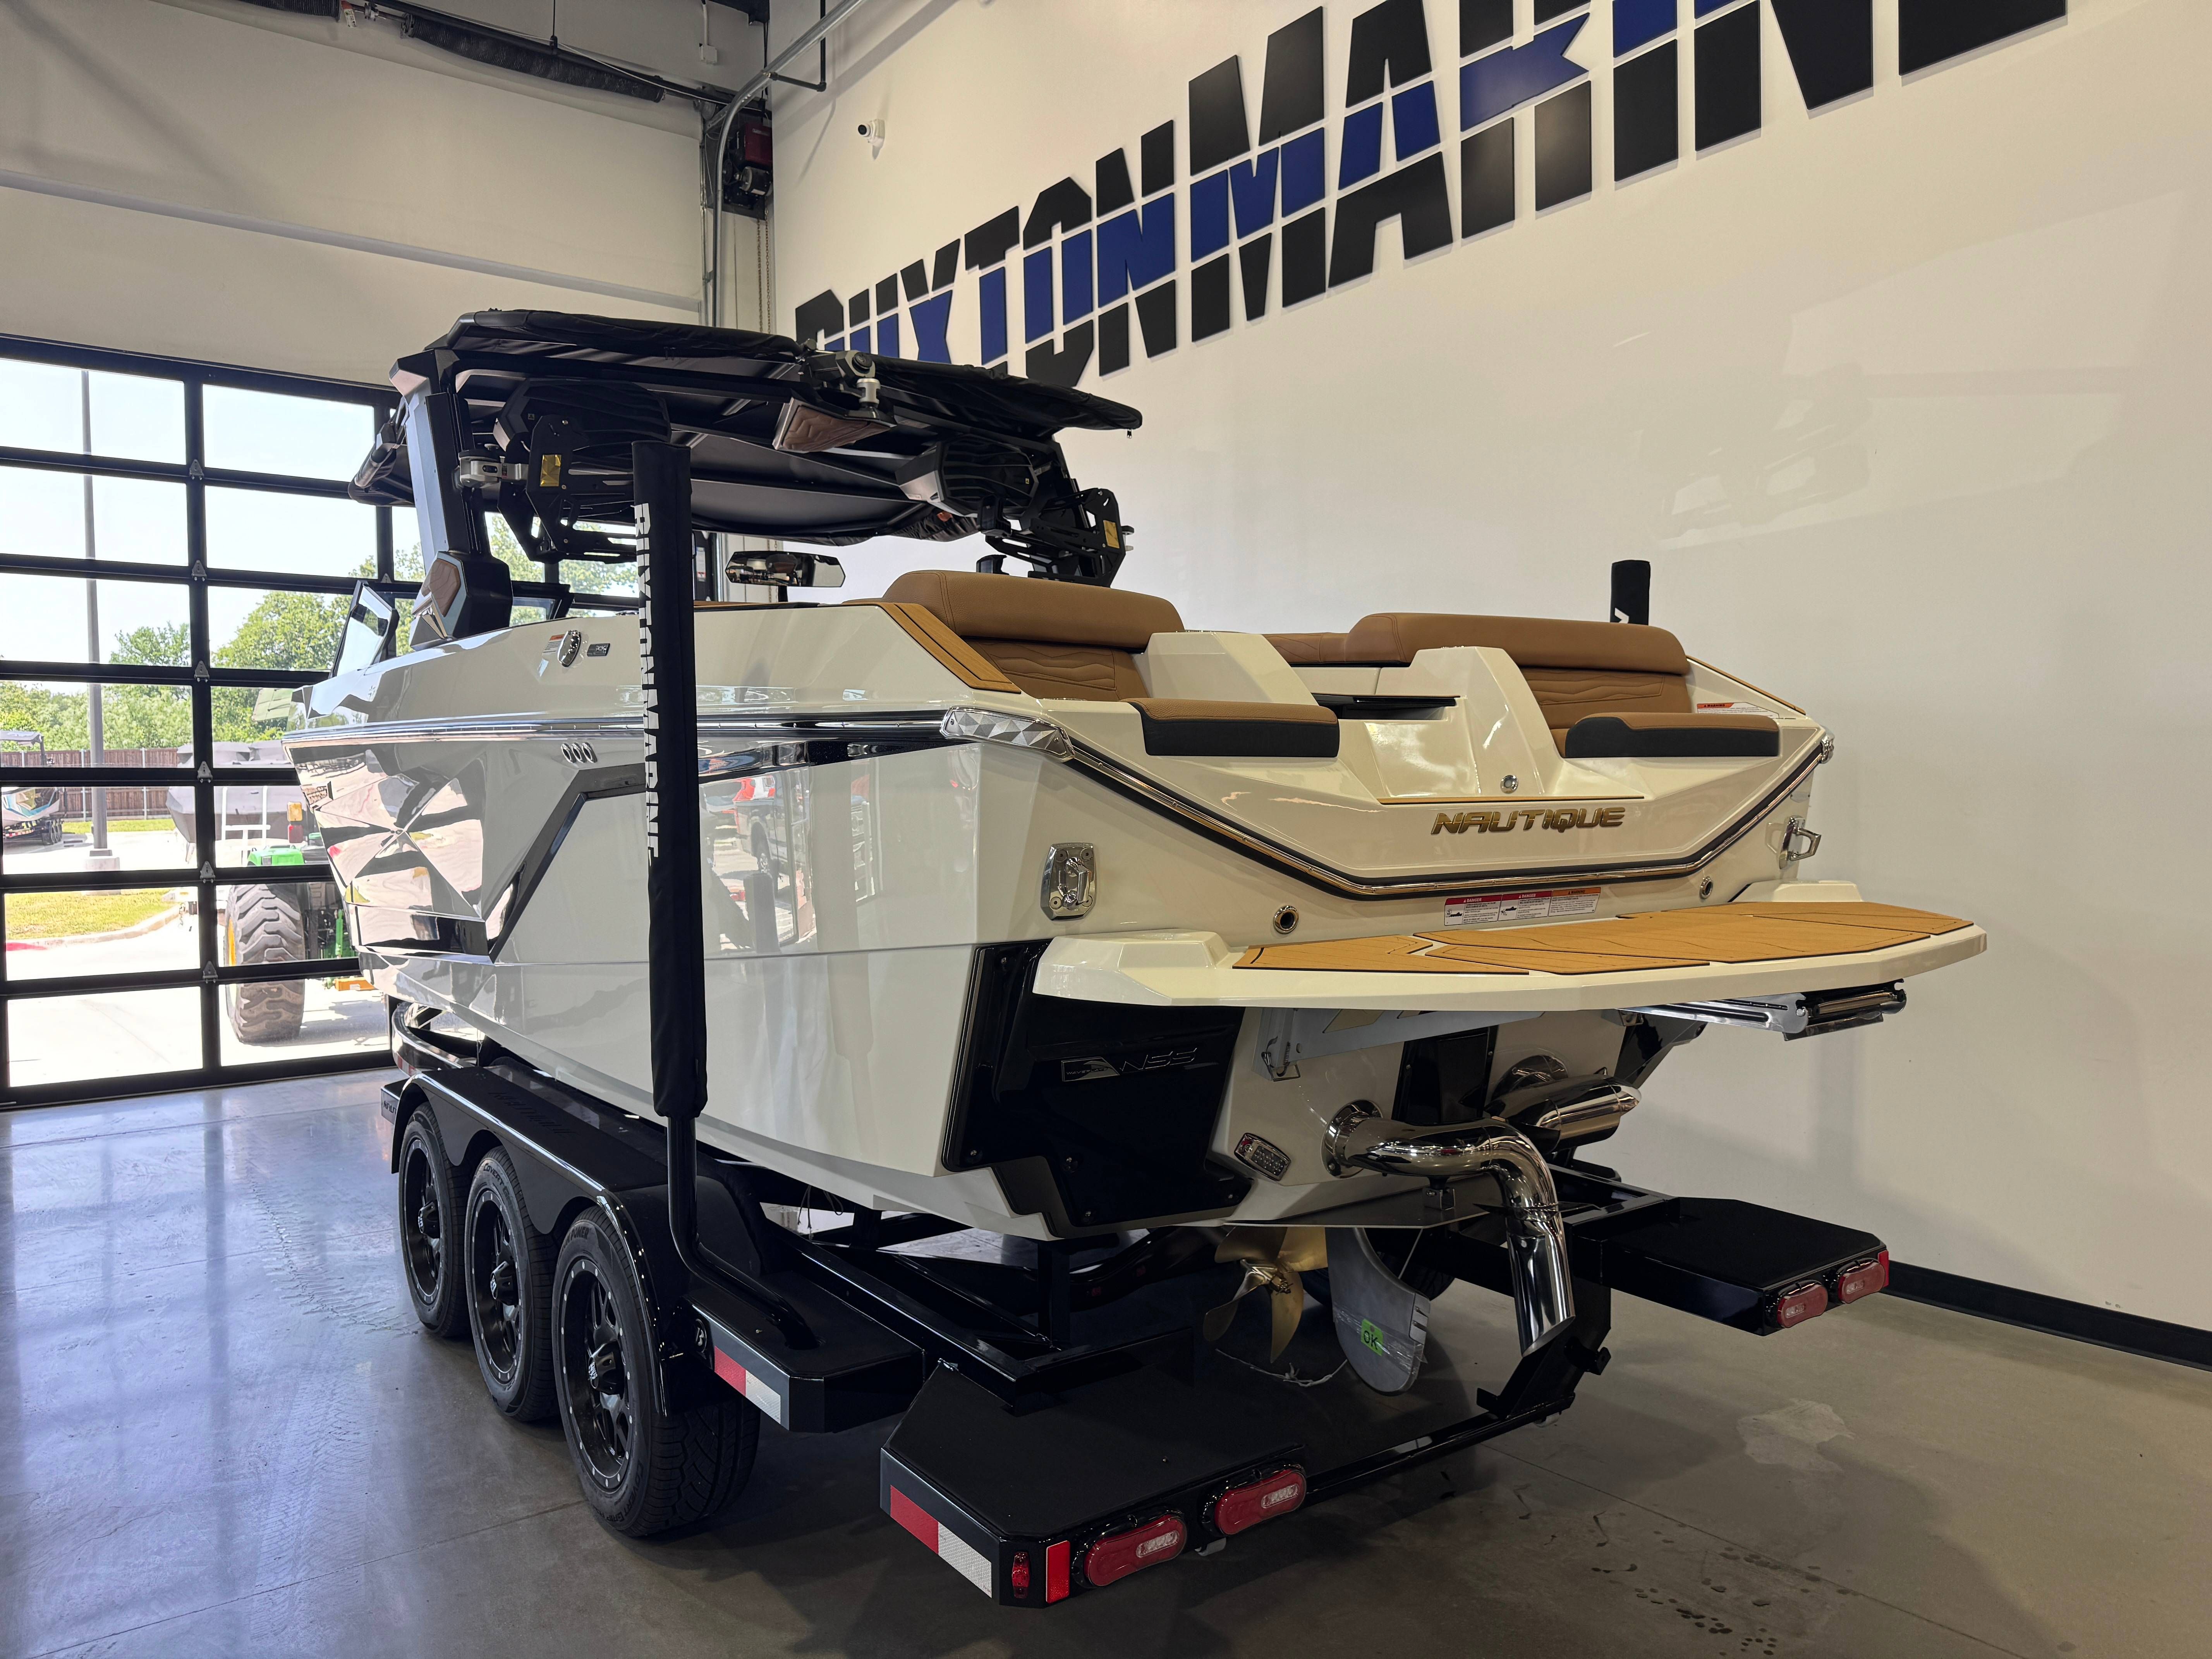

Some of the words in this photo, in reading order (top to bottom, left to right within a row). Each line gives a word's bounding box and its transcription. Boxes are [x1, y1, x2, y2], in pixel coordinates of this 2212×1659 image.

[1431, 807, 1626, 834] NAUTIQUE
[483, 1163, 504, 1185] COVERT
[1364, 1330, 1378, 1350] OK
